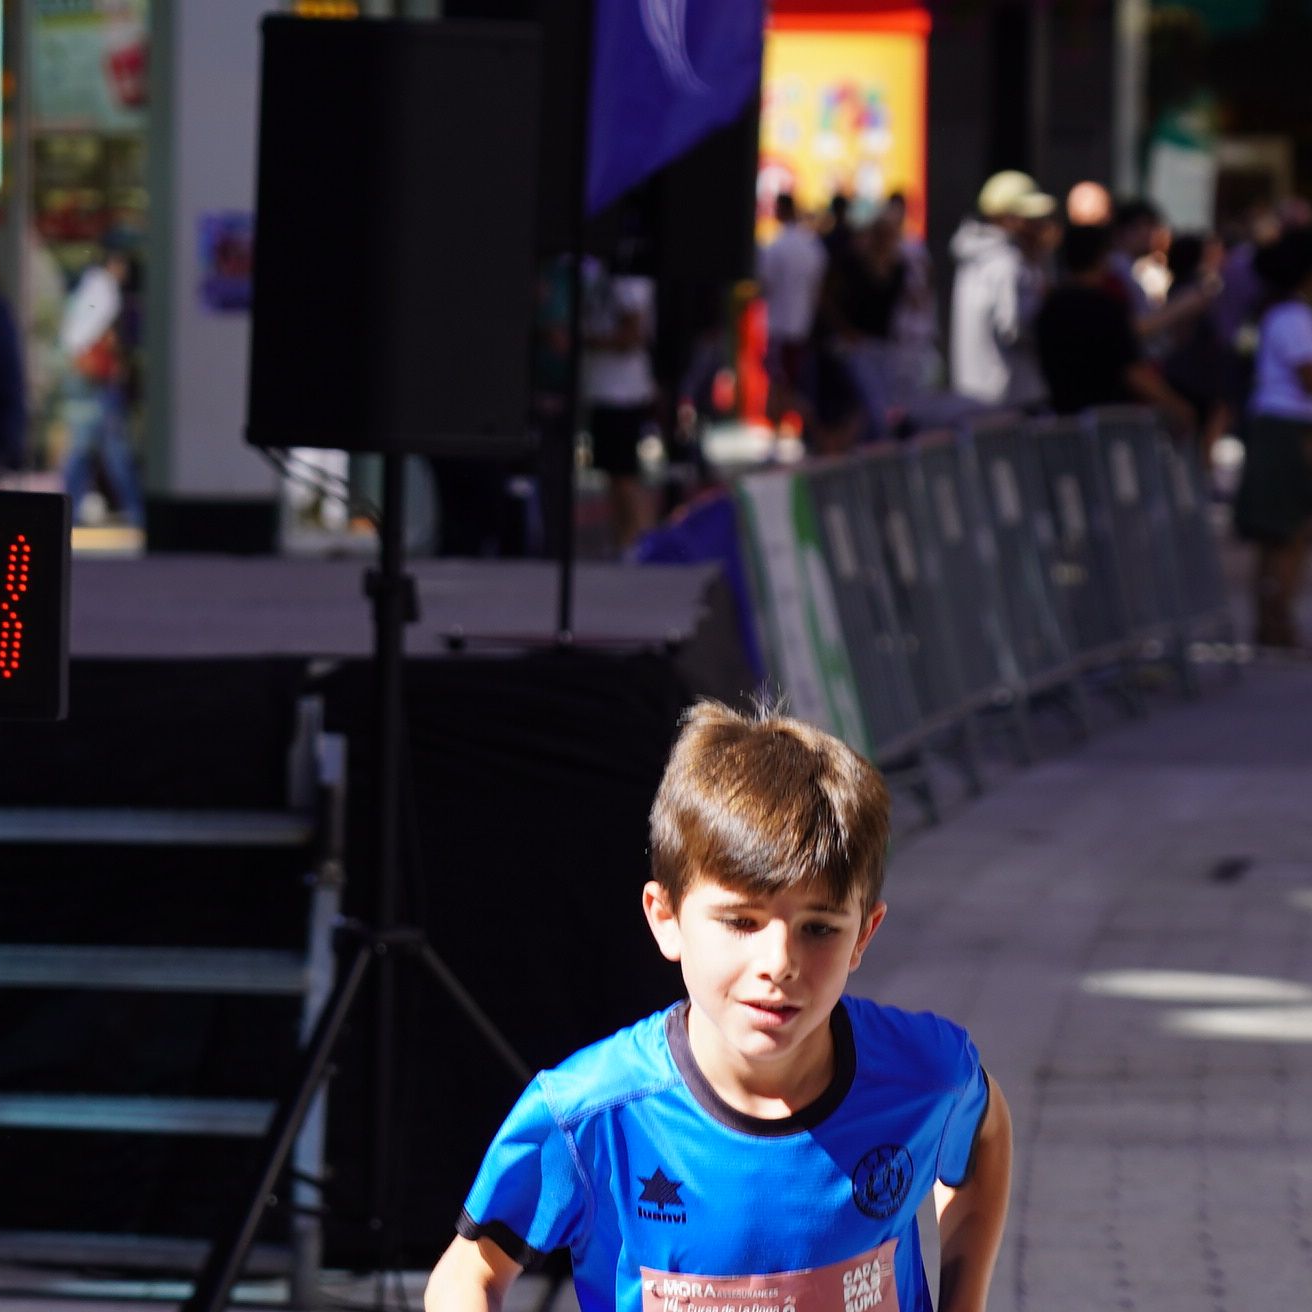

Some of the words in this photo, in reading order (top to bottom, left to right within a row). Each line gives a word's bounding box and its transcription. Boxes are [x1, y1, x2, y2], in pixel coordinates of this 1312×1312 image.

[843, 1259, 881, 1286] CADA
[663, 1279, 716, 1298] MORA
[844, 1274, 881, 1302] PAS
